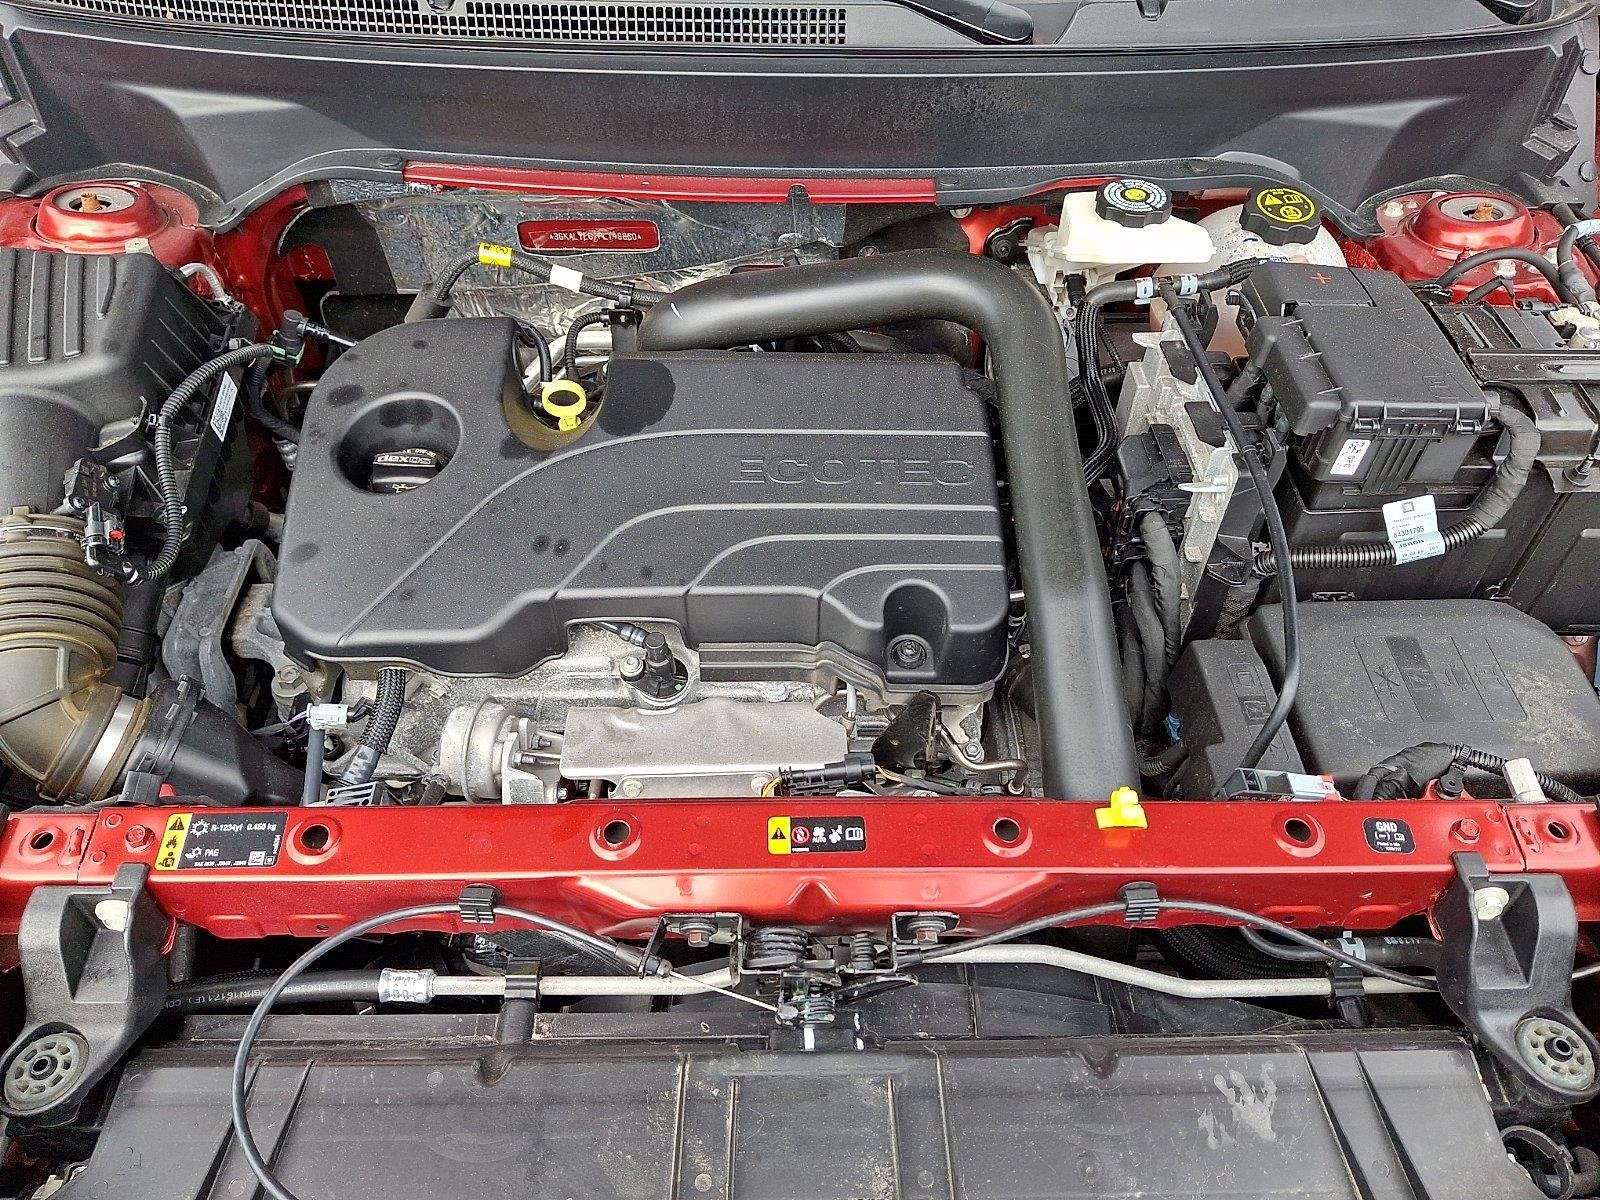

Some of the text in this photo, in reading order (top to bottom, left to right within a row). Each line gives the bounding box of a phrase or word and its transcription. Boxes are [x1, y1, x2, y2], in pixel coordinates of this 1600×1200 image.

[377, 455, 432, 465] dexos
[730, 457, 977, 486] ECOTEC
[246, 823, 266, 831] 0.450
[267, 823, 277, 832] kg
[1376, 821, 1398, 833] GND
[204, 848, 219, 857] PAG
